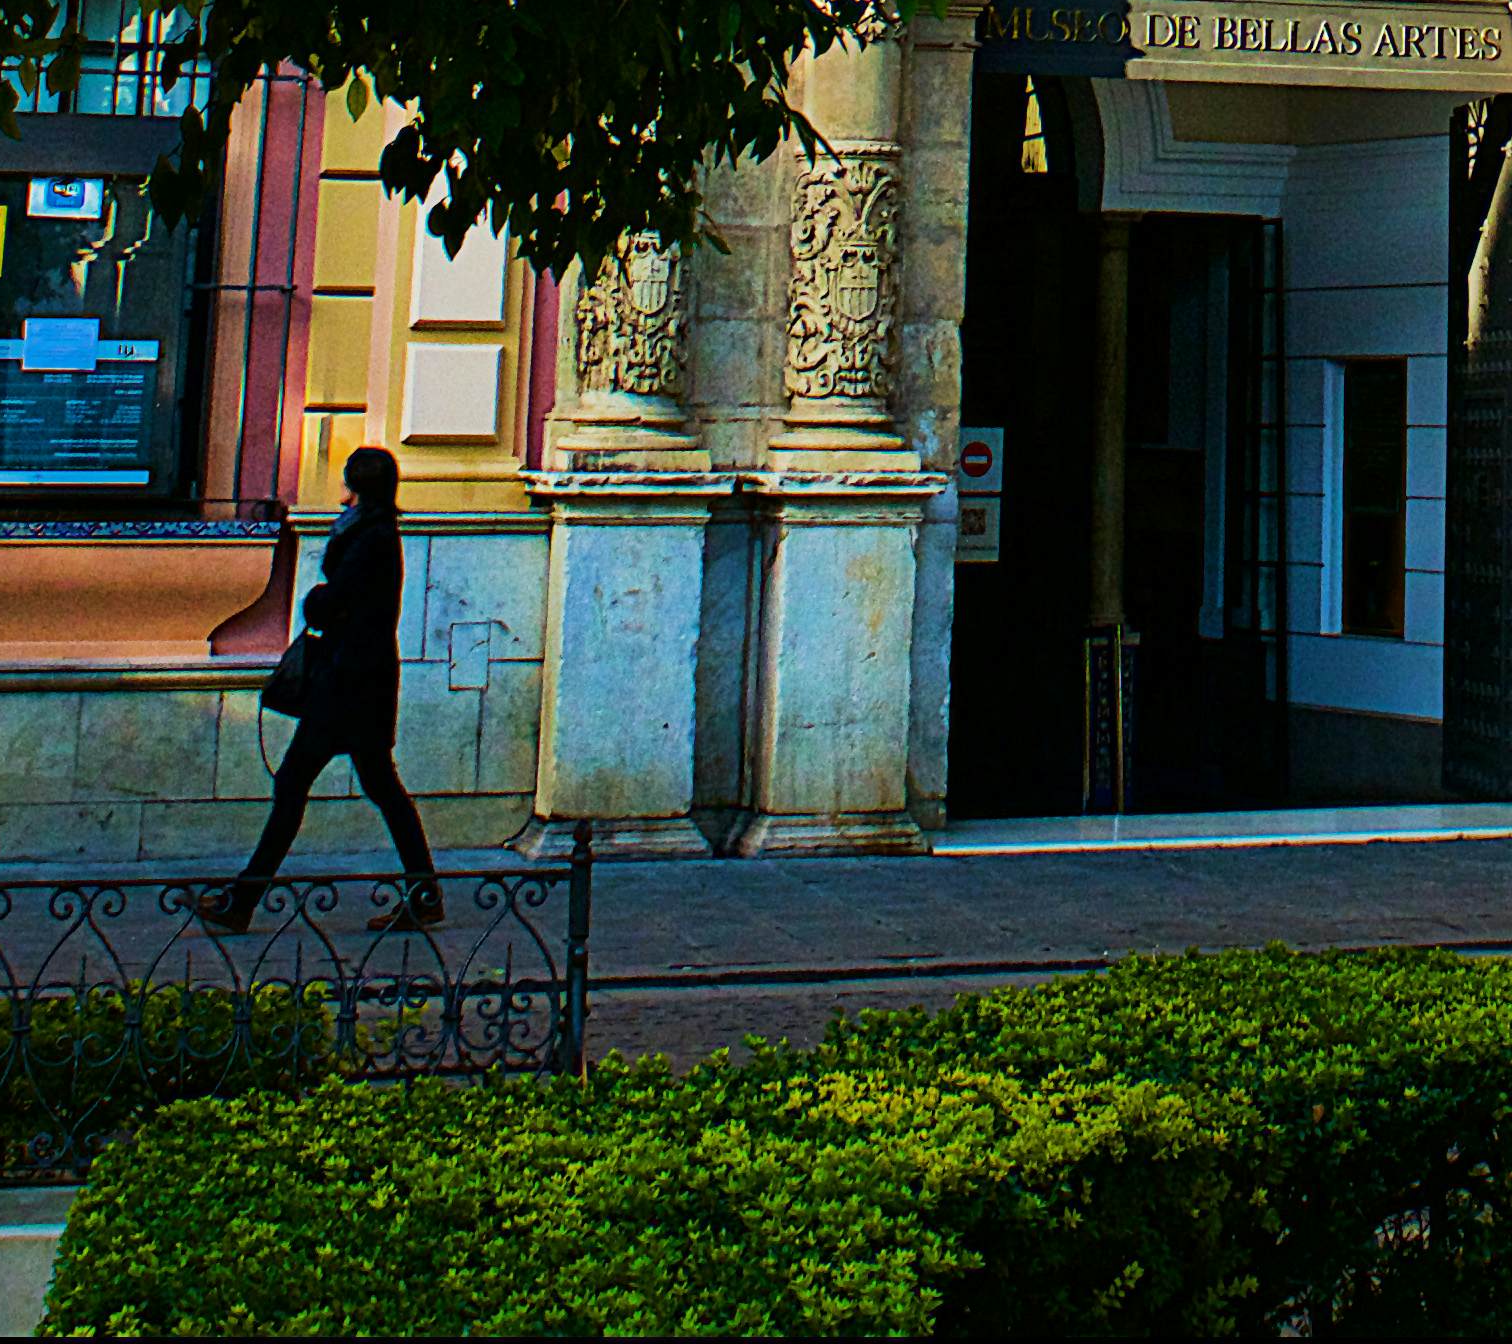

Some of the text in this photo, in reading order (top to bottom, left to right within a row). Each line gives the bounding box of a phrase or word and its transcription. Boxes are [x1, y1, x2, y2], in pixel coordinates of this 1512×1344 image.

[984, 5, 1502, 62] MUSEO DE BELLAS ARTES
